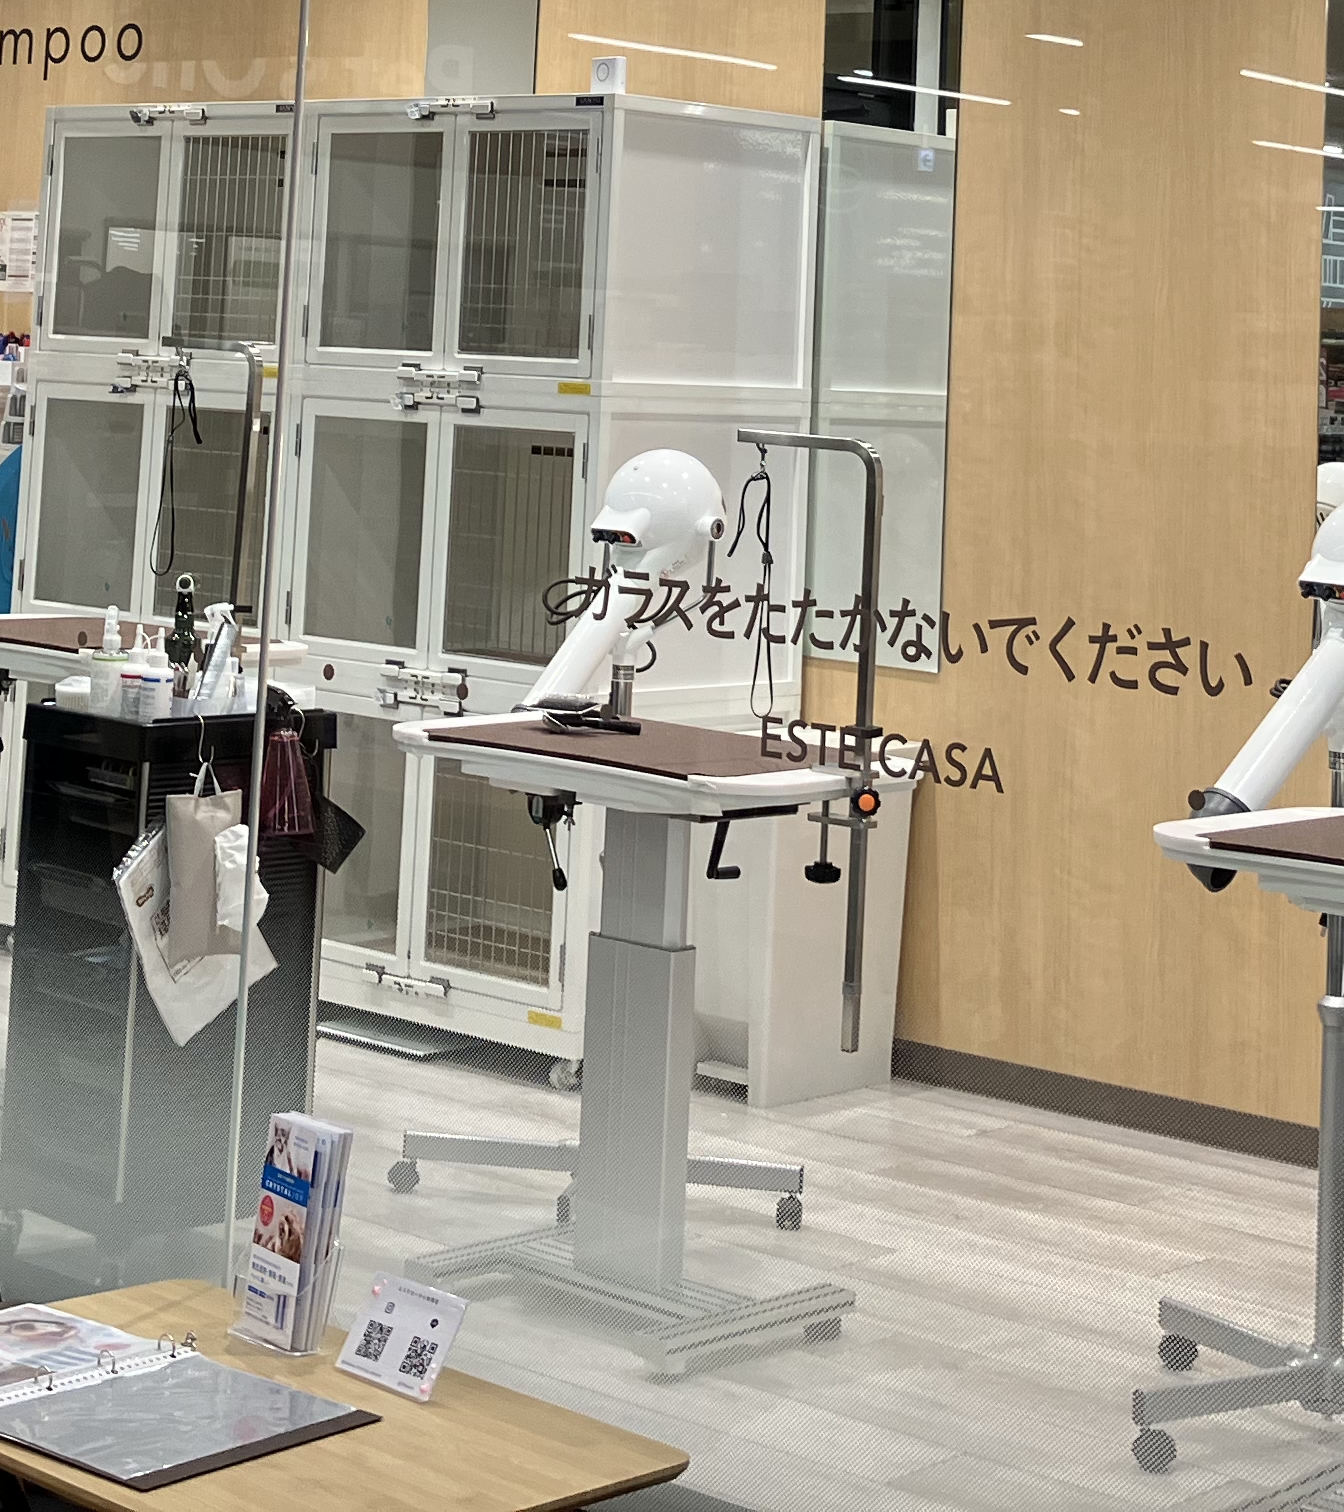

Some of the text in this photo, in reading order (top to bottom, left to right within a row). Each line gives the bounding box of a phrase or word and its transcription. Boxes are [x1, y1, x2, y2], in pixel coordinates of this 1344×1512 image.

[572, 565, 1254, 698] ガラスをたたかないでください
[760, 716, 1004, 794] ESTE CASA
